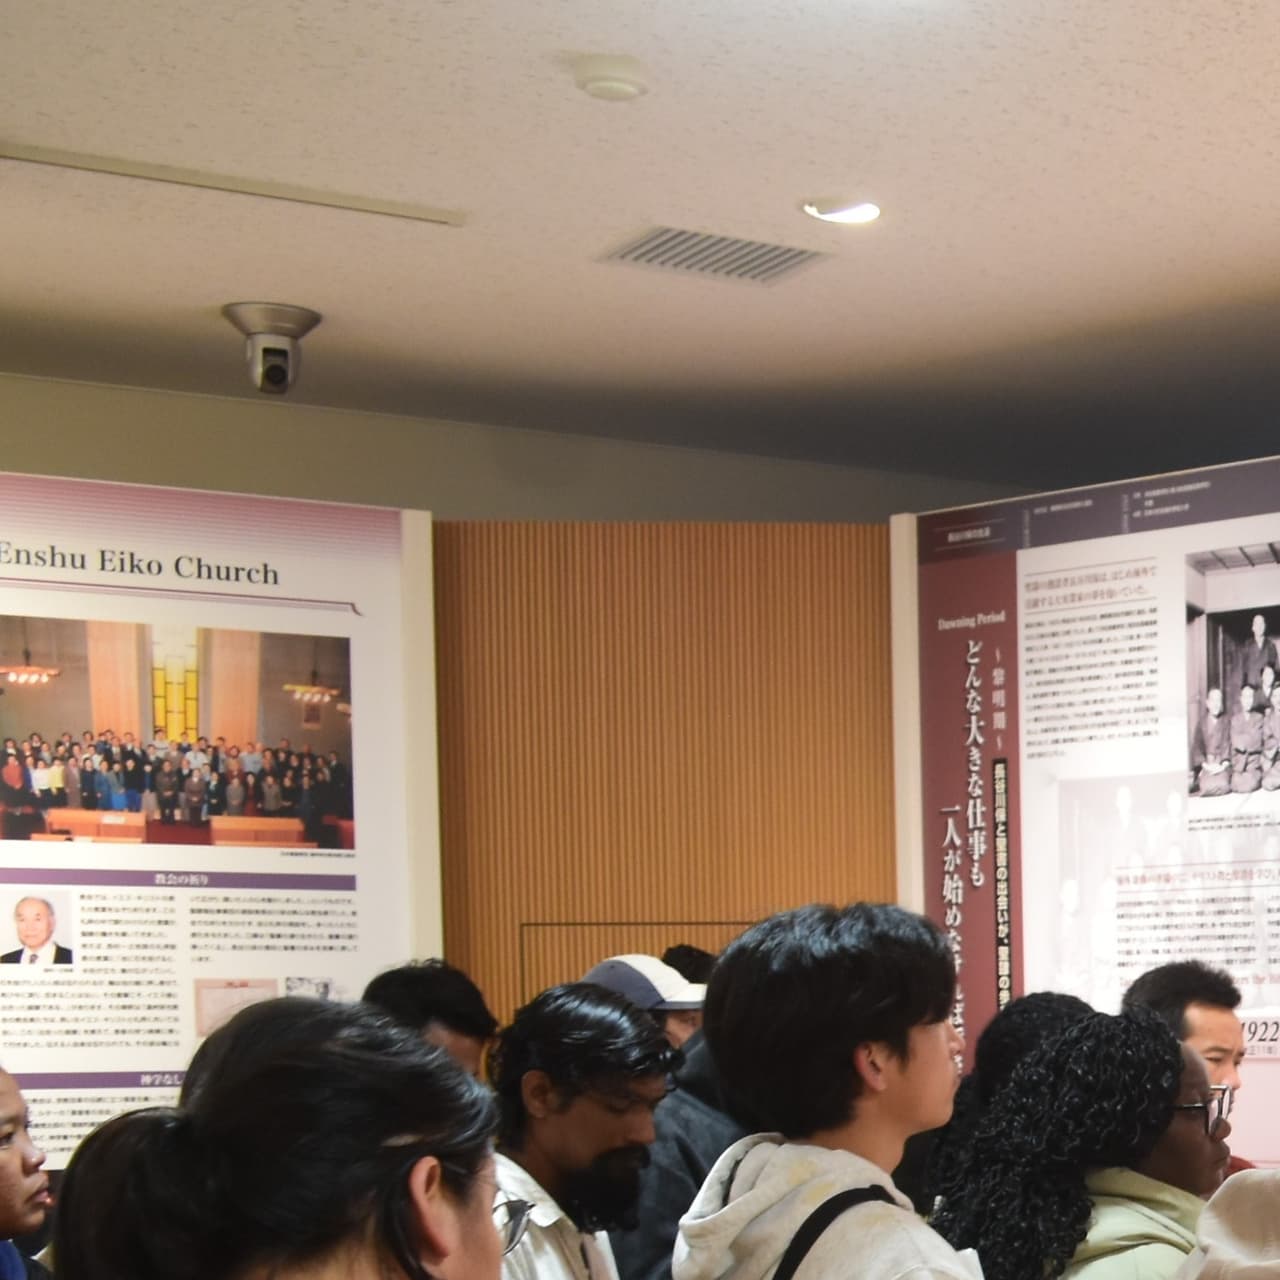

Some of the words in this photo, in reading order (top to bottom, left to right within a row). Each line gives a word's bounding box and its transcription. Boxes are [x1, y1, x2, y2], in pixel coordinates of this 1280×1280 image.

[0, 541, 87, 571] Enshu
[99, 548, 164, 577] Eiko
[174, 555, 281, 586] Church
[977, 609, 1005, 626] Period
[964, 639, 988, 888] どんな大きな仕事も
